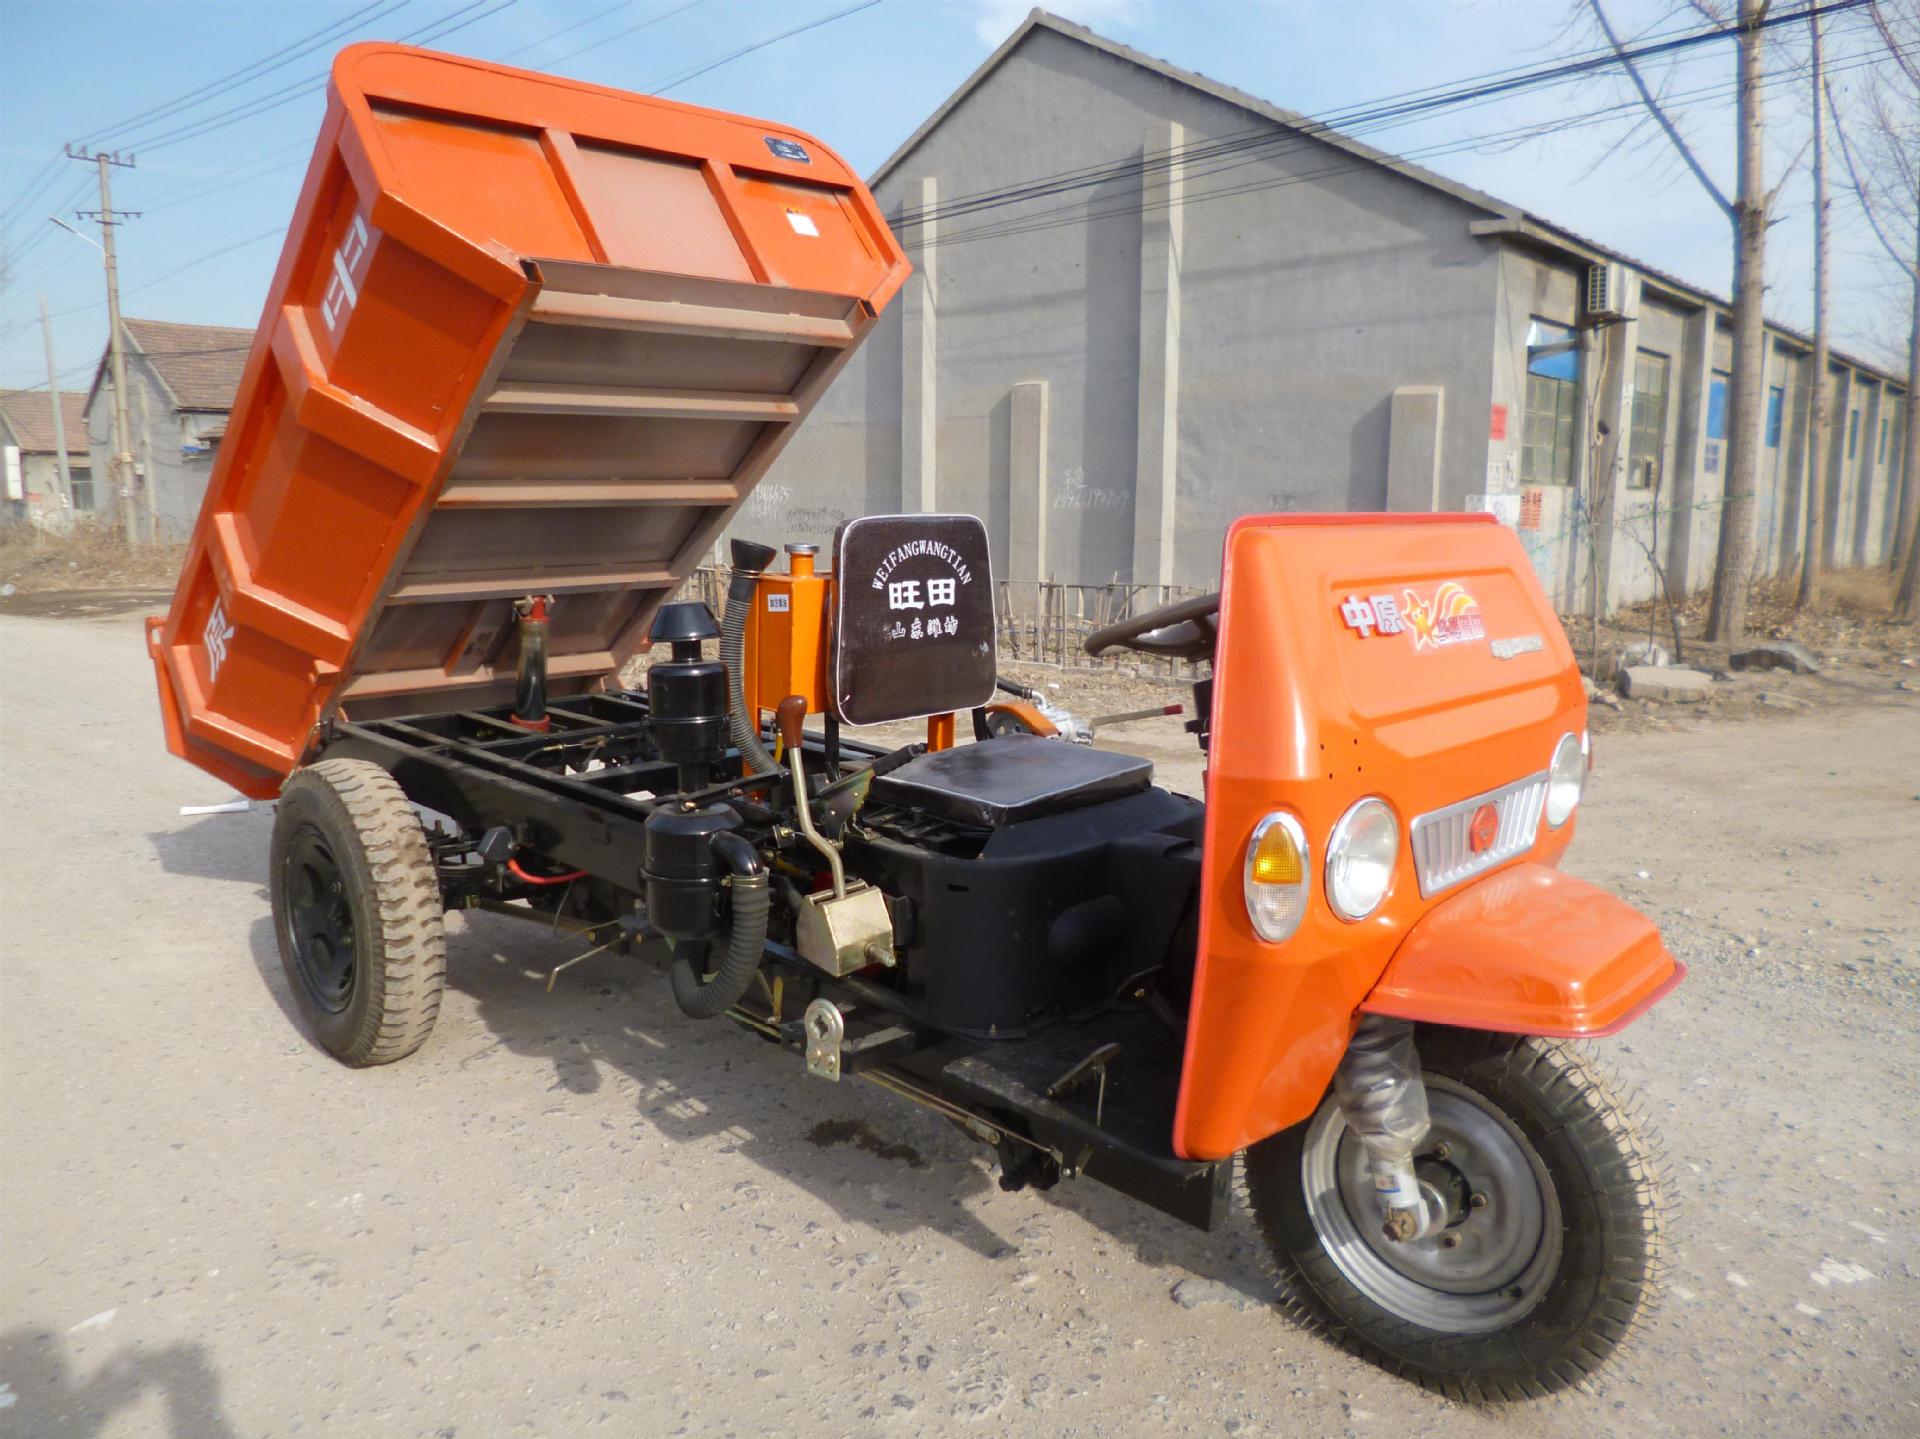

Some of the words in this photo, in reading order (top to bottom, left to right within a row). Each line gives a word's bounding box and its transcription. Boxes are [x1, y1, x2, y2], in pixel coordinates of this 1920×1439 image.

[322, 213, 368, 333] 中
[872, 540, 971, 591] WEIFANGWANGTIAN
[888, 578, 956, 610] 旺田
[1340, 595, 1403, 638] 中原
